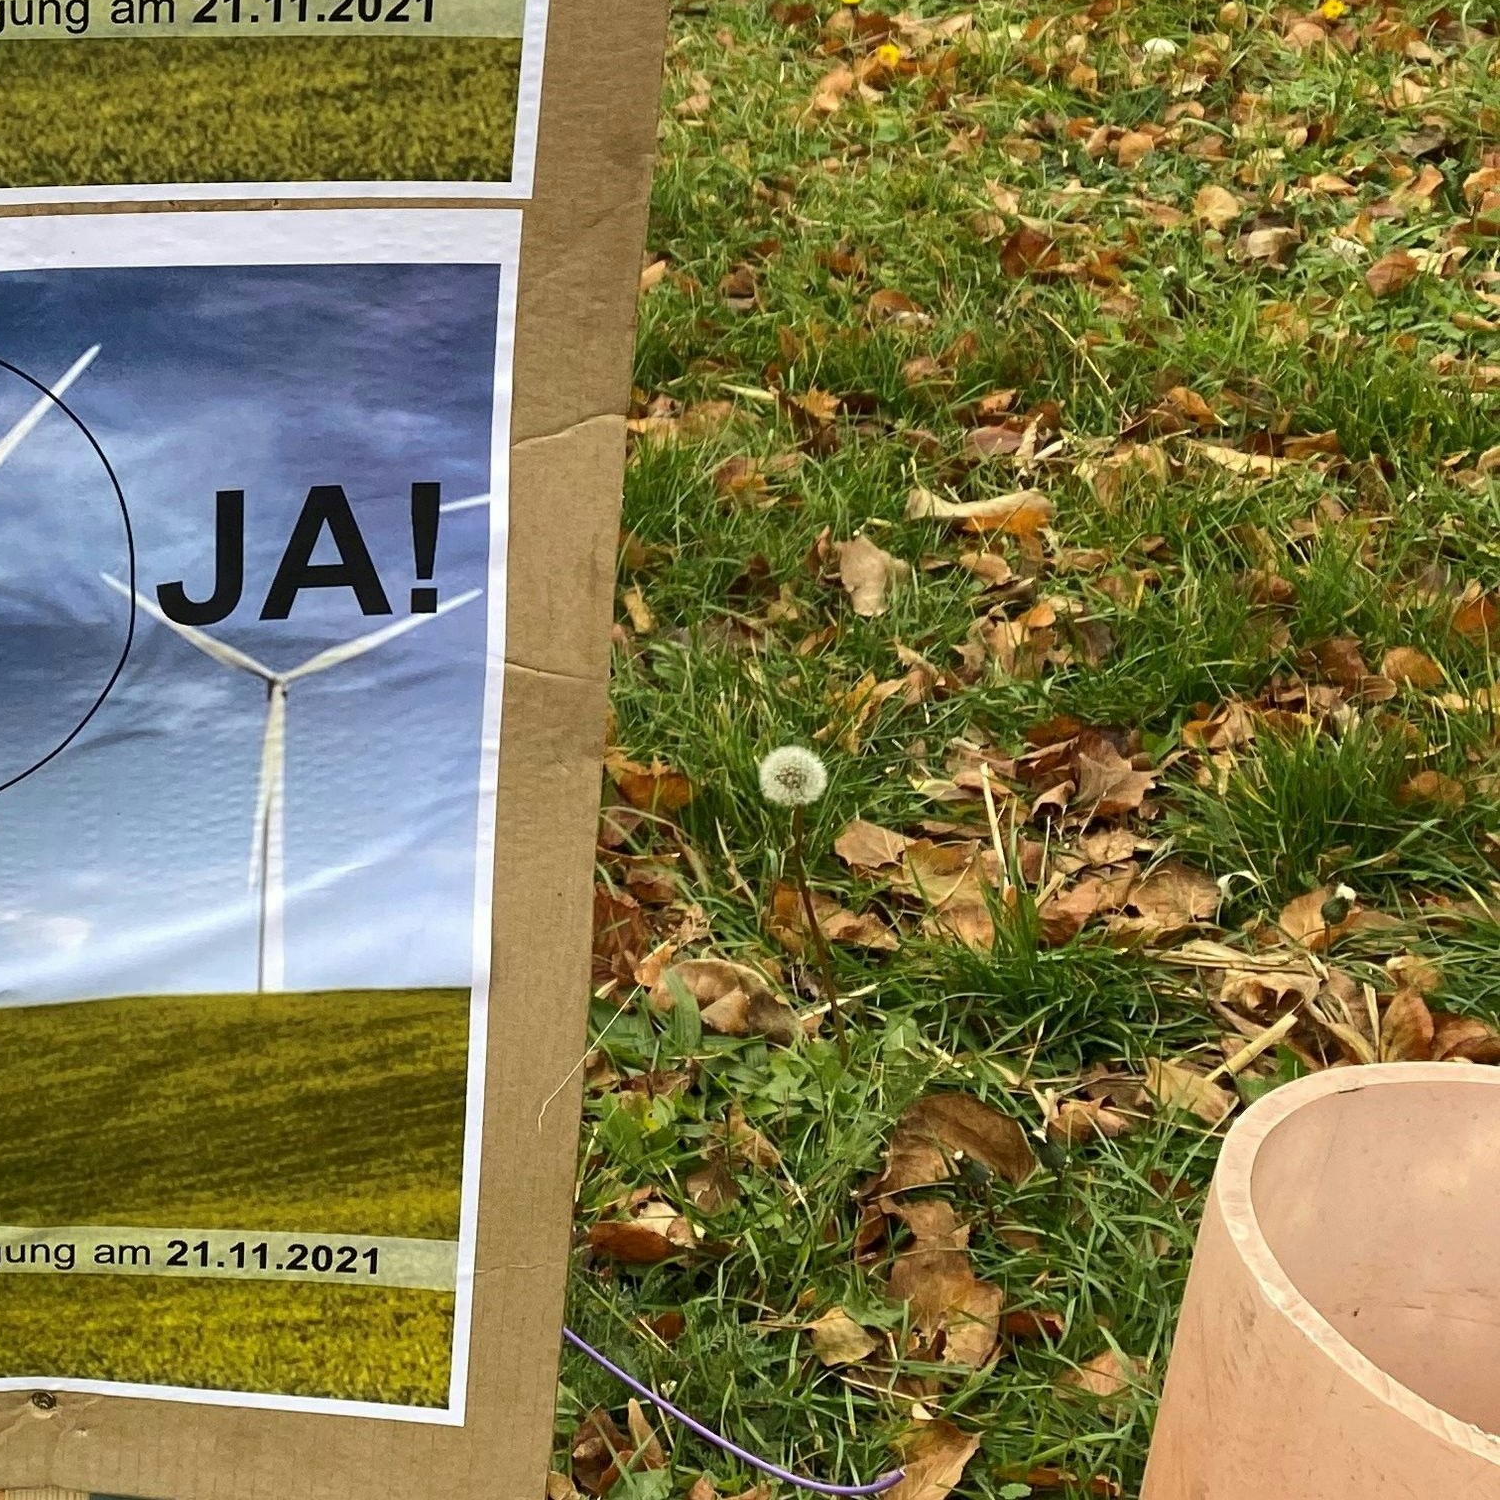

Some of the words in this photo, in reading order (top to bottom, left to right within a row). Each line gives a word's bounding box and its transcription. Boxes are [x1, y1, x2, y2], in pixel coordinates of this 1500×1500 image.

[156, 482, 441, 627] JA!
[93, 1242, 152, 1267] am
[166, 1240, 380, 1275] 21.11.2021
